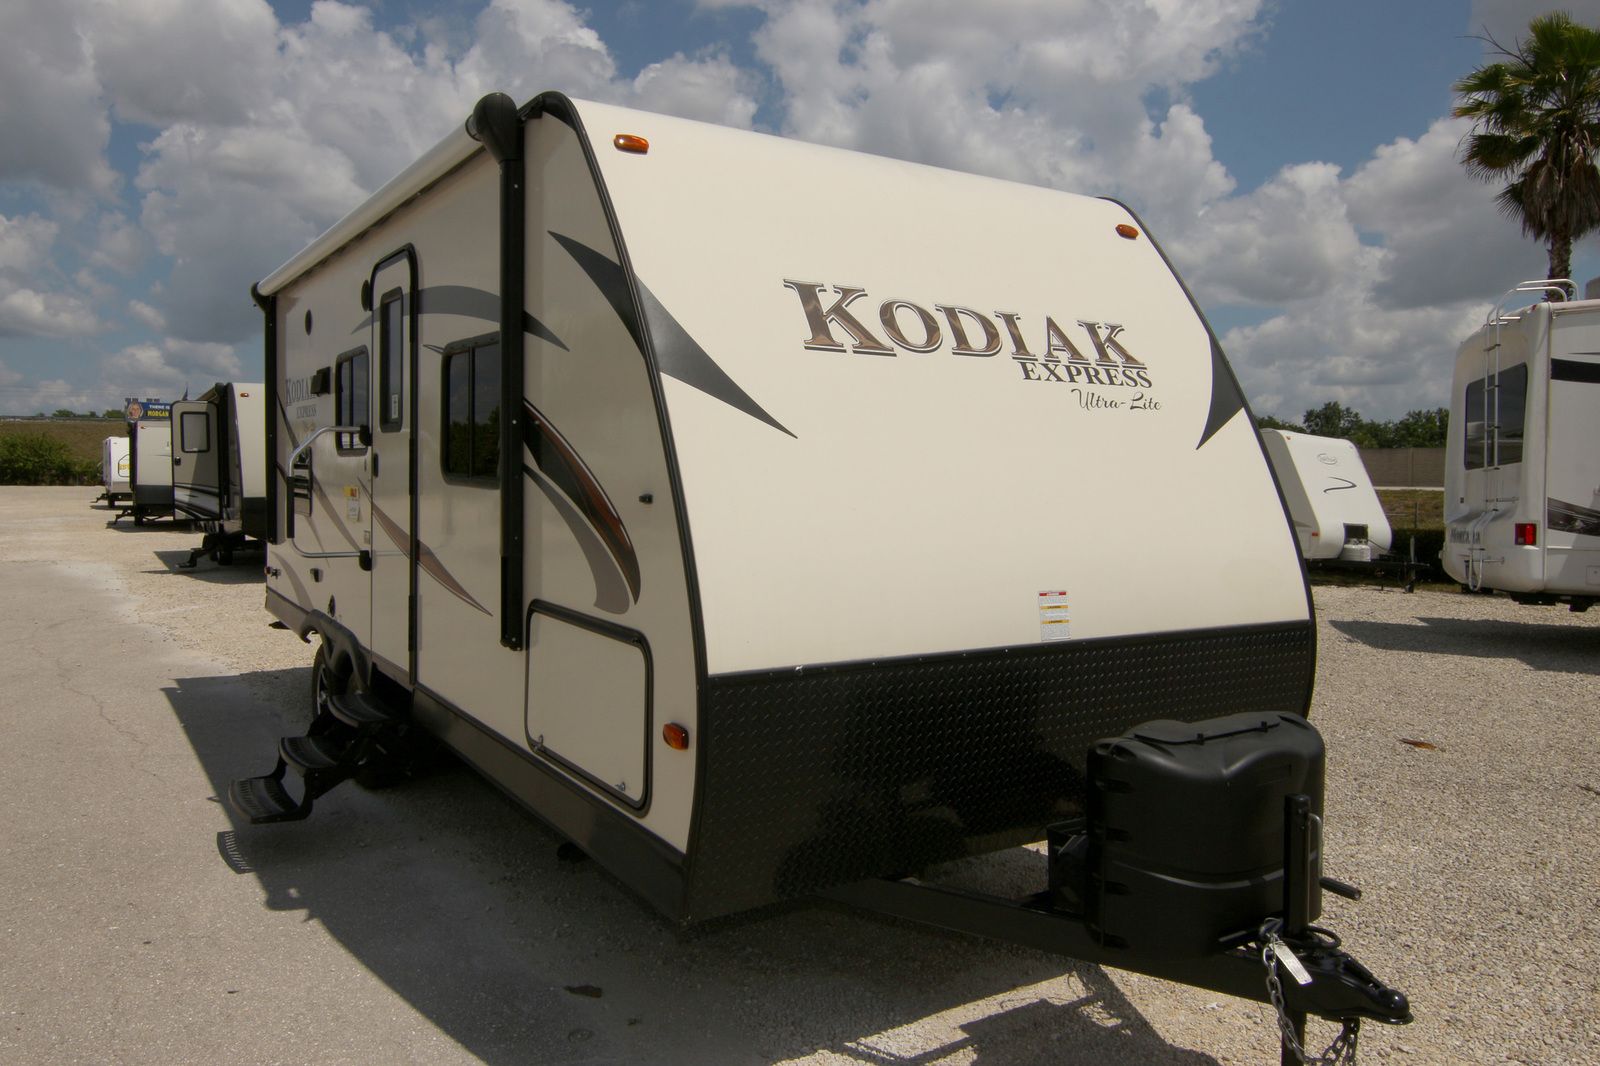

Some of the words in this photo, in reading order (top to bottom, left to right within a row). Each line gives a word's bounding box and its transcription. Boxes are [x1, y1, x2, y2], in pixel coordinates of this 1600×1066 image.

[782, 278, 1147, 369] KODIAK
[1018, 361, 1153, 388] EXPRESS
[1071, 389, 1161, 410] Ultra-Lite
